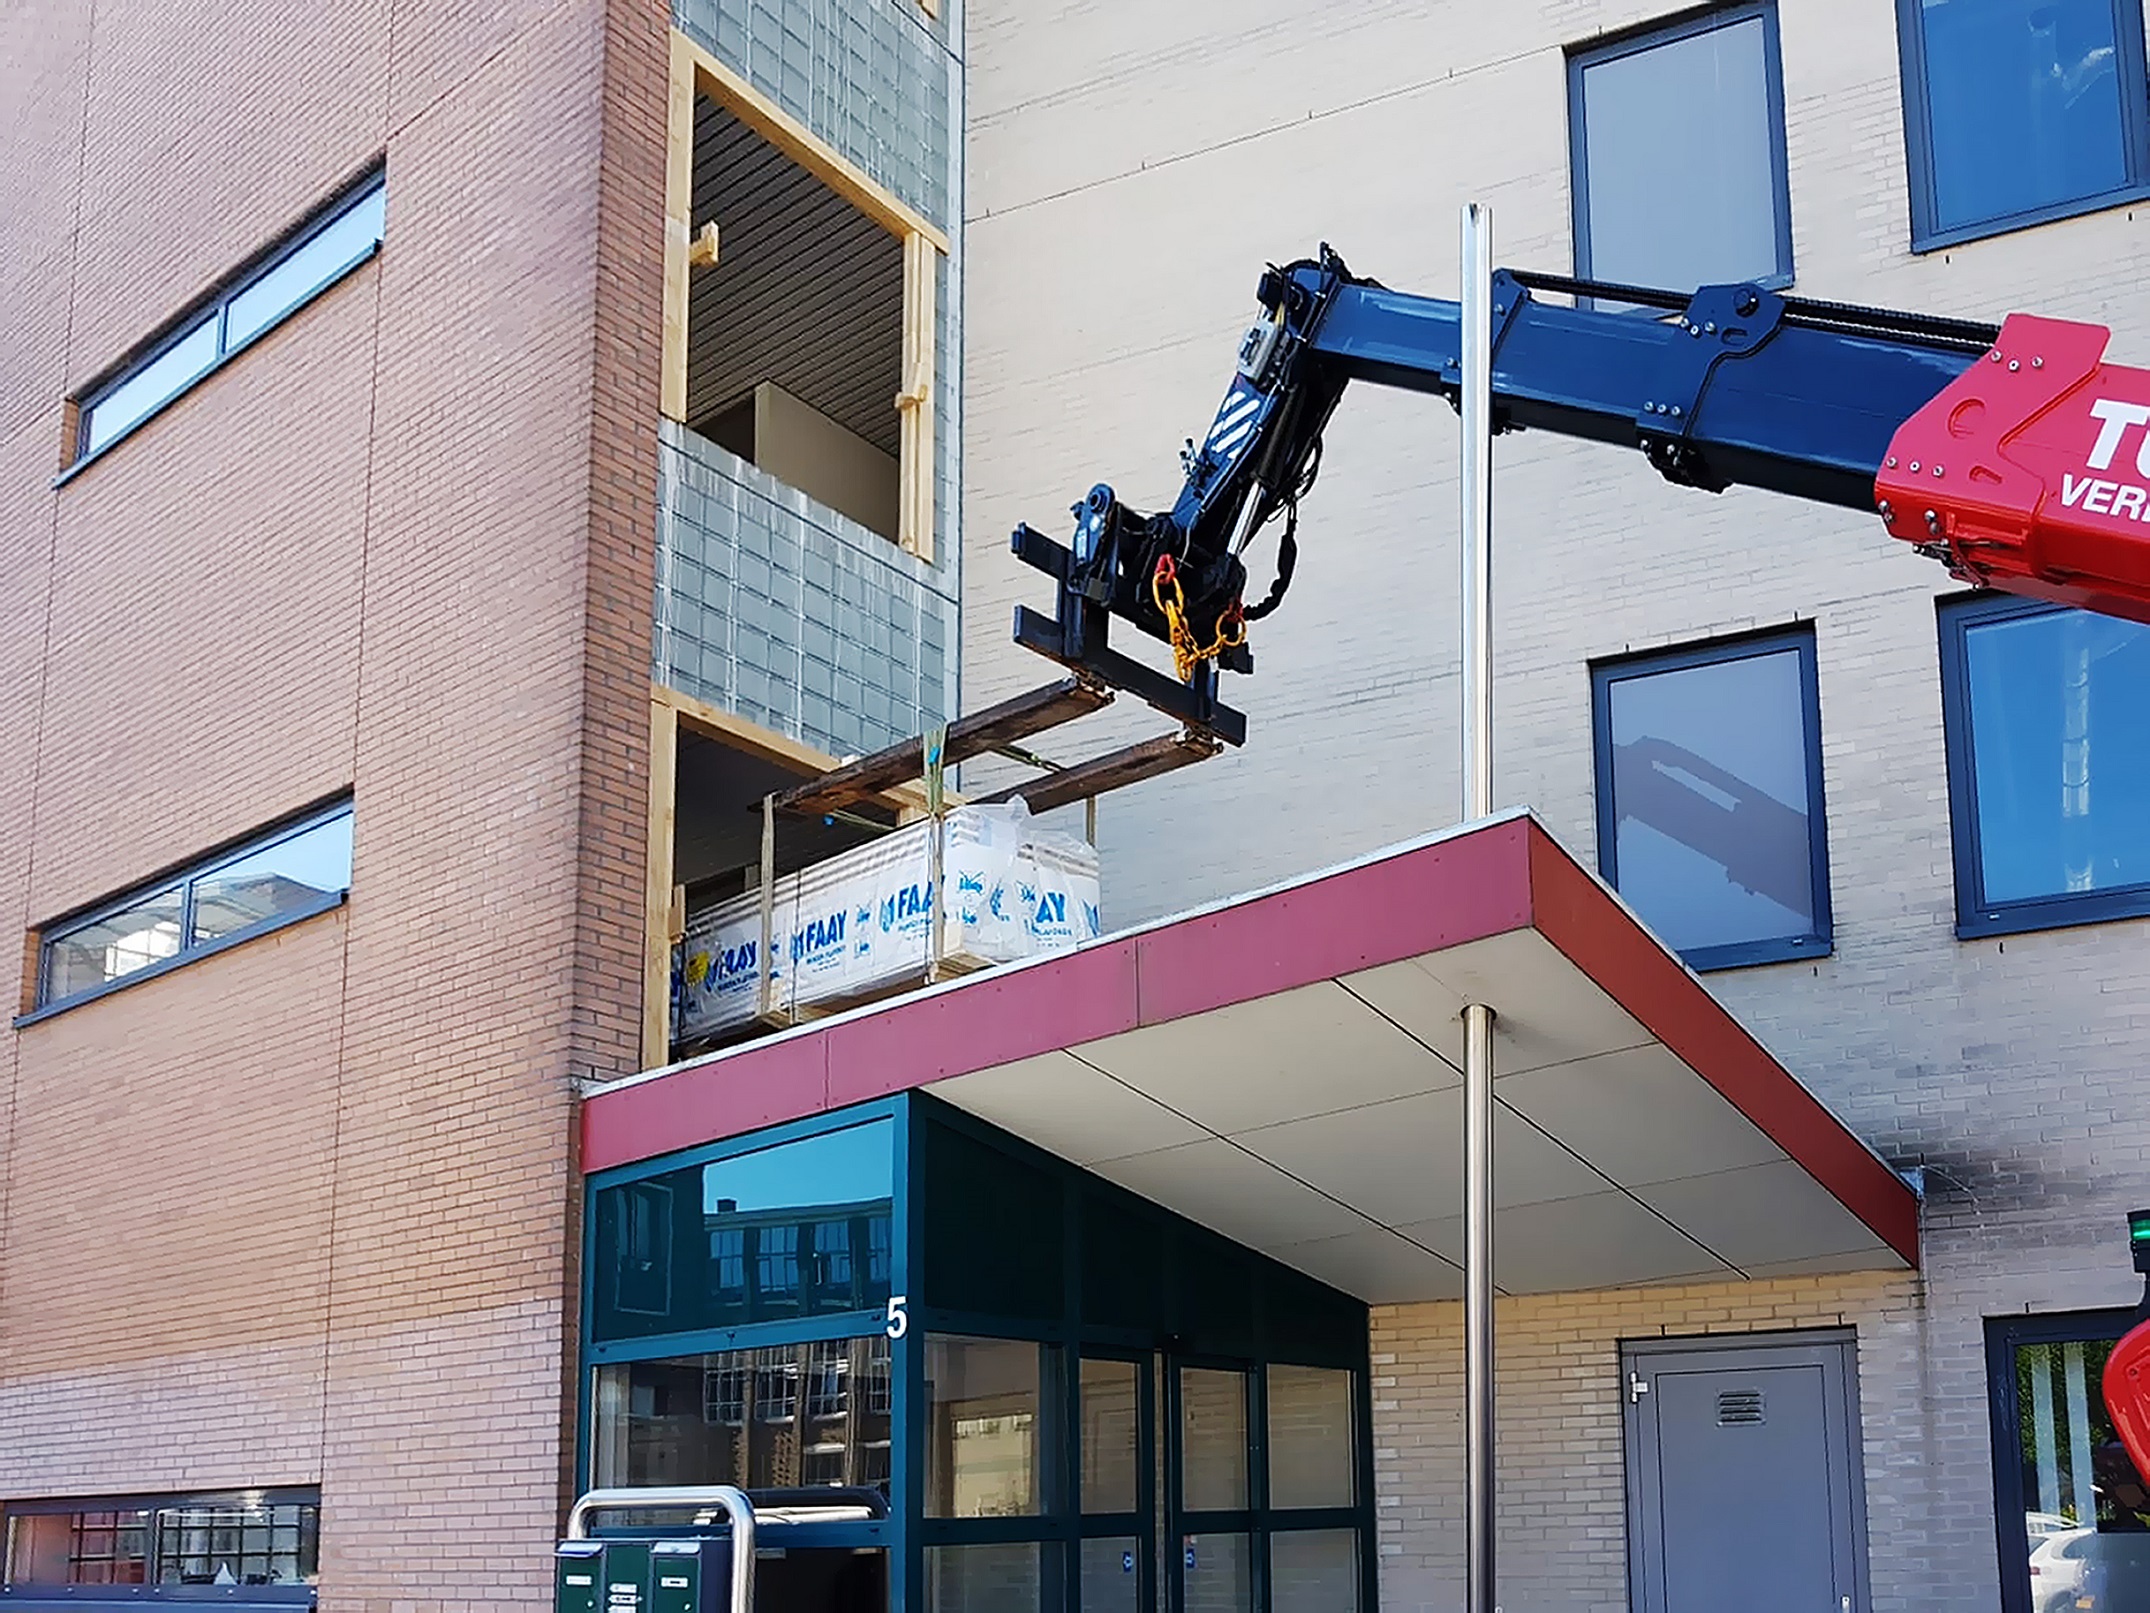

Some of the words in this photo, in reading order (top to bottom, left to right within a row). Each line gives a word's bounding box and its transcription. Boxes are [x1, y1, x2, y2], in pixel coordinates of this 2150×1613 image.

[2086, 398, 2150, 480] T
[898, 875, 945, 919] FAA
[806, 909, 847, 952] FAAY
[887, 1296, 907, 1338] 5
